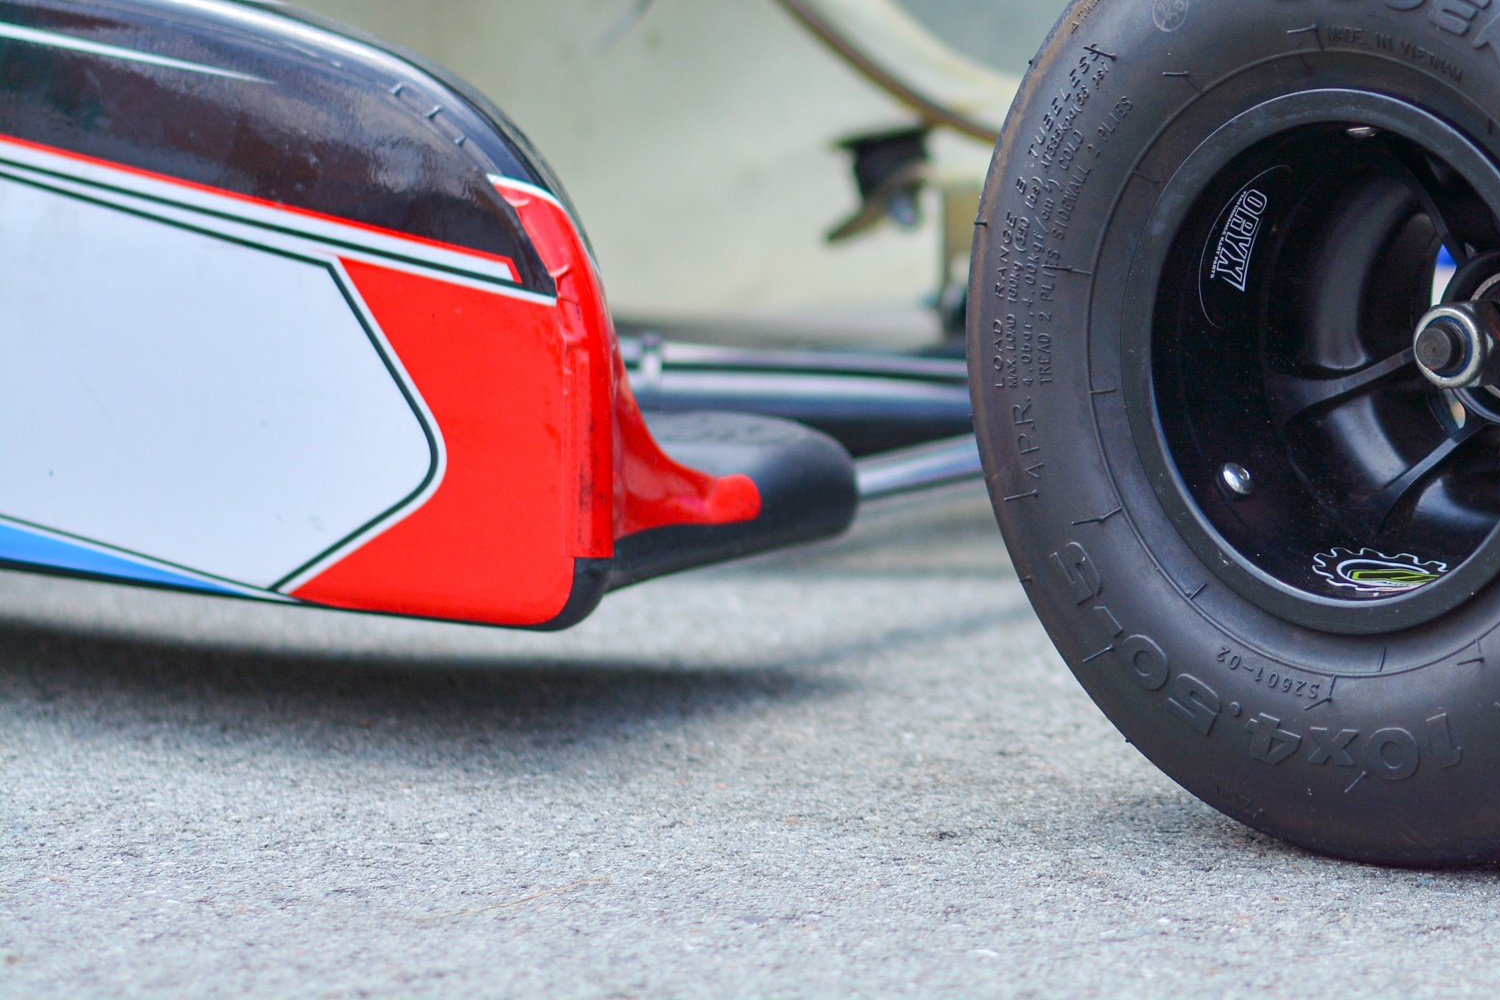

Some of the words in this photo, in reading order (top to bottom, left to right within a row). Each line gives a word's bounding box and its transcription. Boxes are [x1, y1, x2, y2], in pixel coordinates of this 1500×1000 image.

[1325, 24, 1364, 45] MADE
[1375, 31, 1393, 51] IN
[1400, 37, 1464, 84] VIETNAM
[1028, 41, 1102, 159] TUBELESS
[1096, 95, 1135, 142] PLIES
[1058, 128, 1084, 173] COLD
[1086, 143, 1102, 159] 2
[1014, 216, 1031, 252] (350
[1025, 176, 1045, 211] lbs)
[1051, 164, 1092, 241] SIDEWALL
[1222, 190, 1247, 238] PERFORMANCE
[994, 211, 1018, 300] RANGE
[1216, 188, 1268, 283] ORYX
[1216, 238, 1225, 254] KART
[1040, 247, 1061, 302] PLIES
[1209, 256, 1219, 279] PARTS
[1038, 310, 1053, 324] 2
[993, 319, 1006, 389] LOAD
[1039, 333, 1053, 387] TREAD
